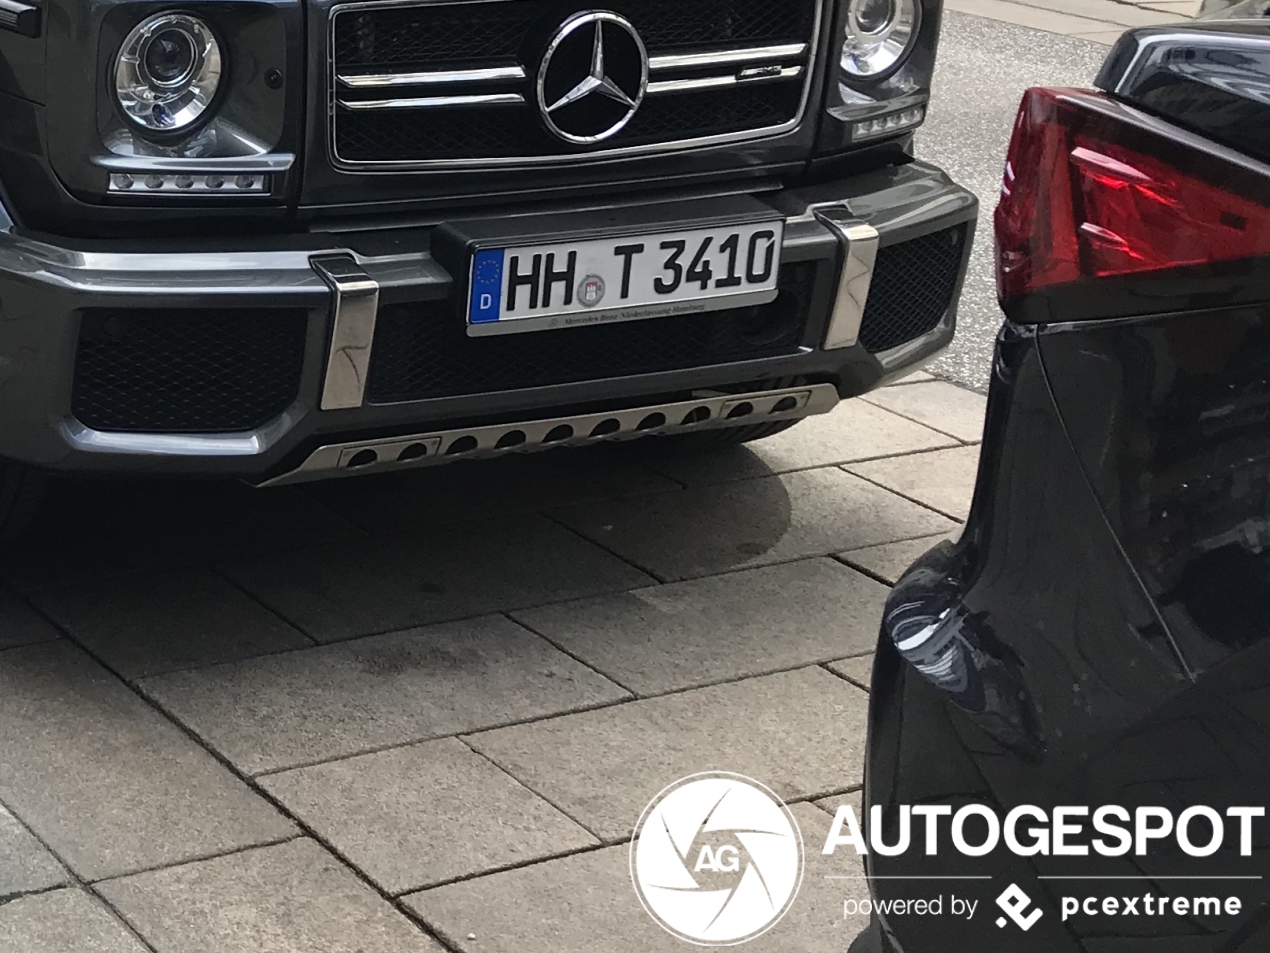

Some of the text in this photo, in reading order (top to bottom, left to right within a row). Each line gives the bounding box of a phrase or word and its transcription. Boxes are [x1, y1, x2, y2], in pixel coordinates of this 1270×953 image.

[506, 230, 775, 311] HH T 3410
[480, 294, 491, 309] D
